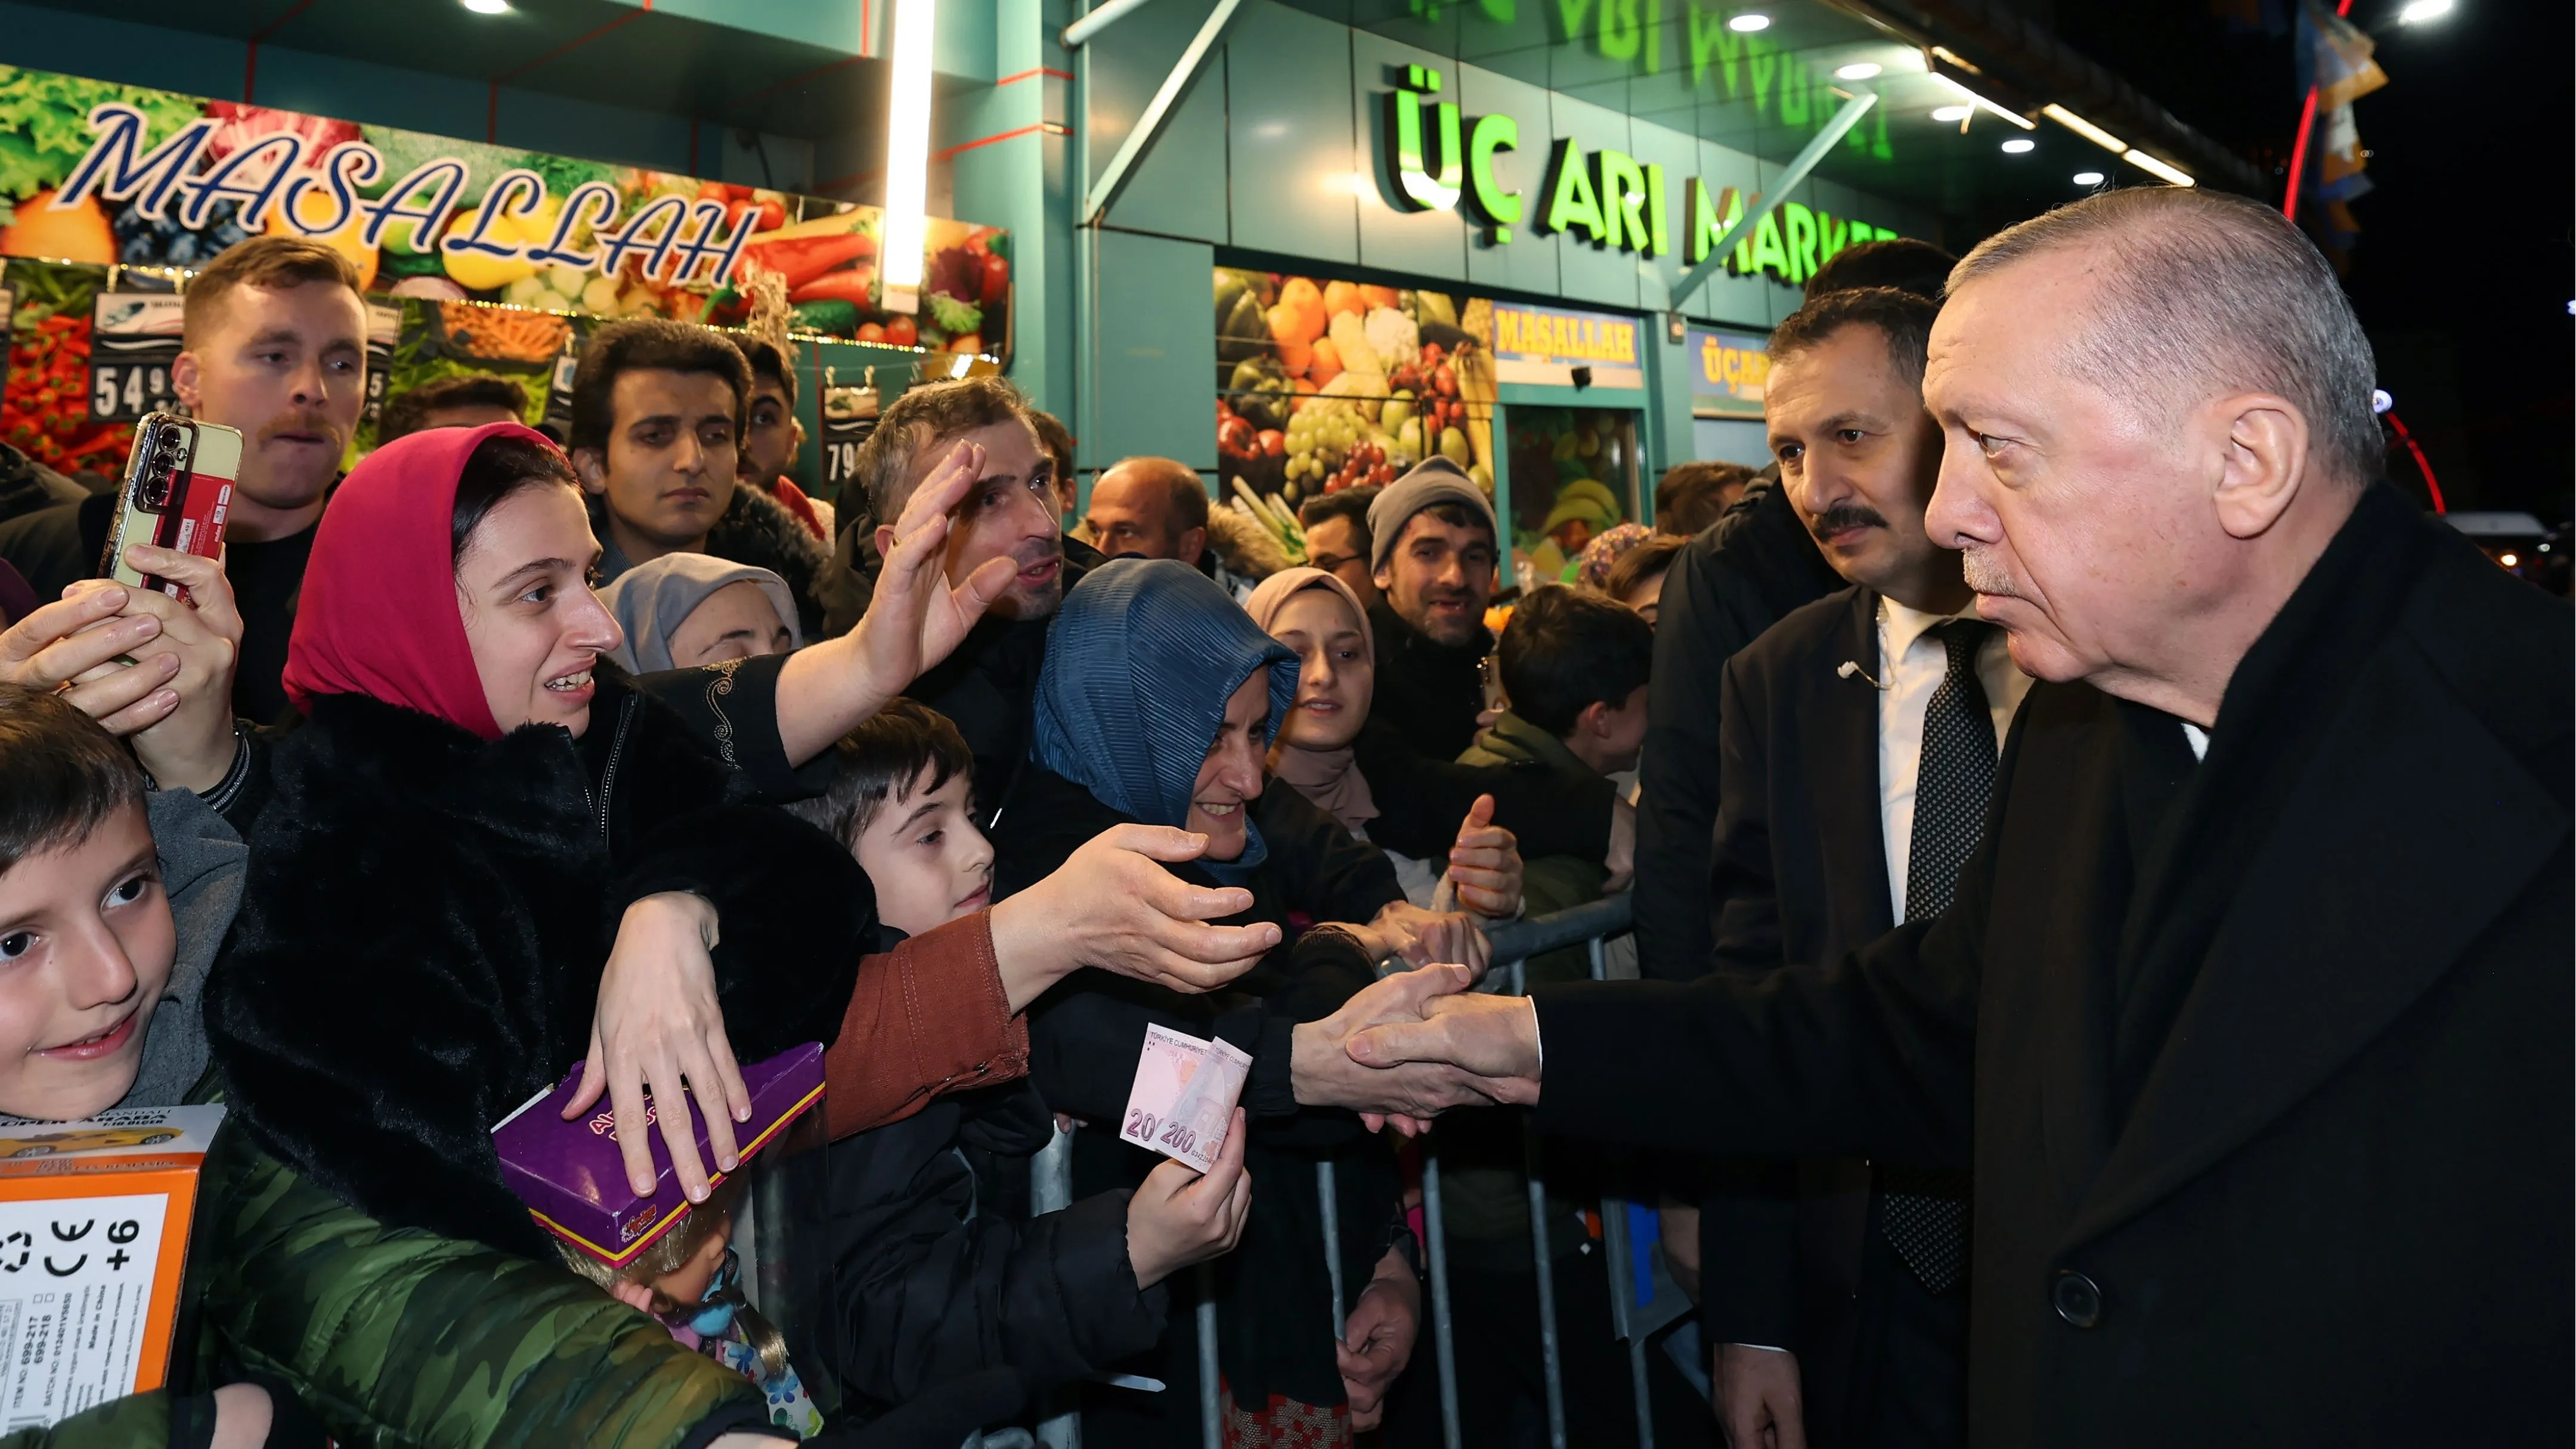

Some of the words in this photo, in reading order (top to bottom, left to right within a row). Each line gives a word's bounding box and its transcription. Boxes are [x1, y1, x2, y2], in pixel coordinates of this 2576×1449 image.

[1389, 64, 1522, 244] ÜÇ
[1544, 137, 1668, 257] ARI
[1690, 177, 1899, 284] MARK
[1494, 308, 1635, 364] MAŞALLAH
[1150, 1031, 1174, 1045] TÜRKİYE
[1160, 1121, 1196, 1153] 200
[21, 1316, 38, 1365] 699-217
[34, 1314, 52, 1364] 699-218
[88, 1324, 99, 1349] Made
[96, 1284, 106, 1311] China
